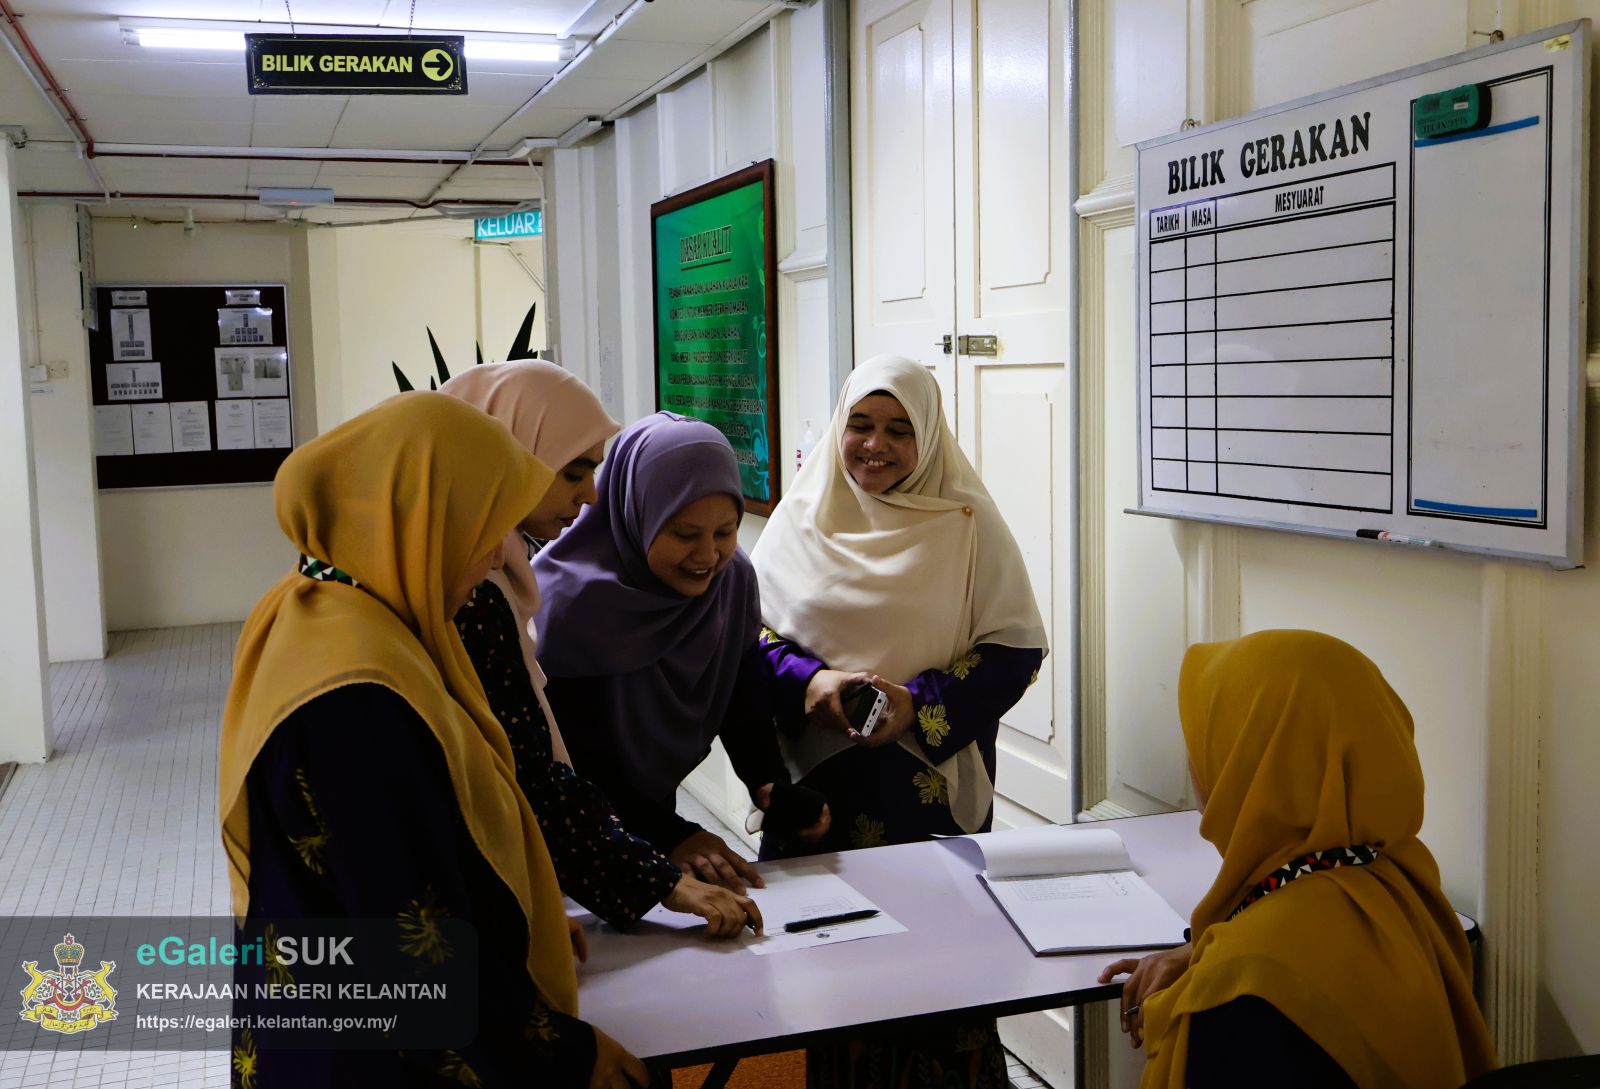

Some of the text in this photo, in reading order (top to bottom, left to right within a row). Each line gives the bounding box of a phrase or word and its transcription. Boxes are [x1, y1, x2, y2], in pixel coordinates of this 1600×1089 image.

[262, 55, 413, 72] BILIK GERAKAN
[1168, 112, 1372, 195] BILIK GERAKAN
[1275, 186, 1324, 213] MESYUARAT
[478, 212, 535, 237] KELUAR
[1156, 212, 1180, 234] TARIKH
[1191, 207, 1212, 228] MASA
